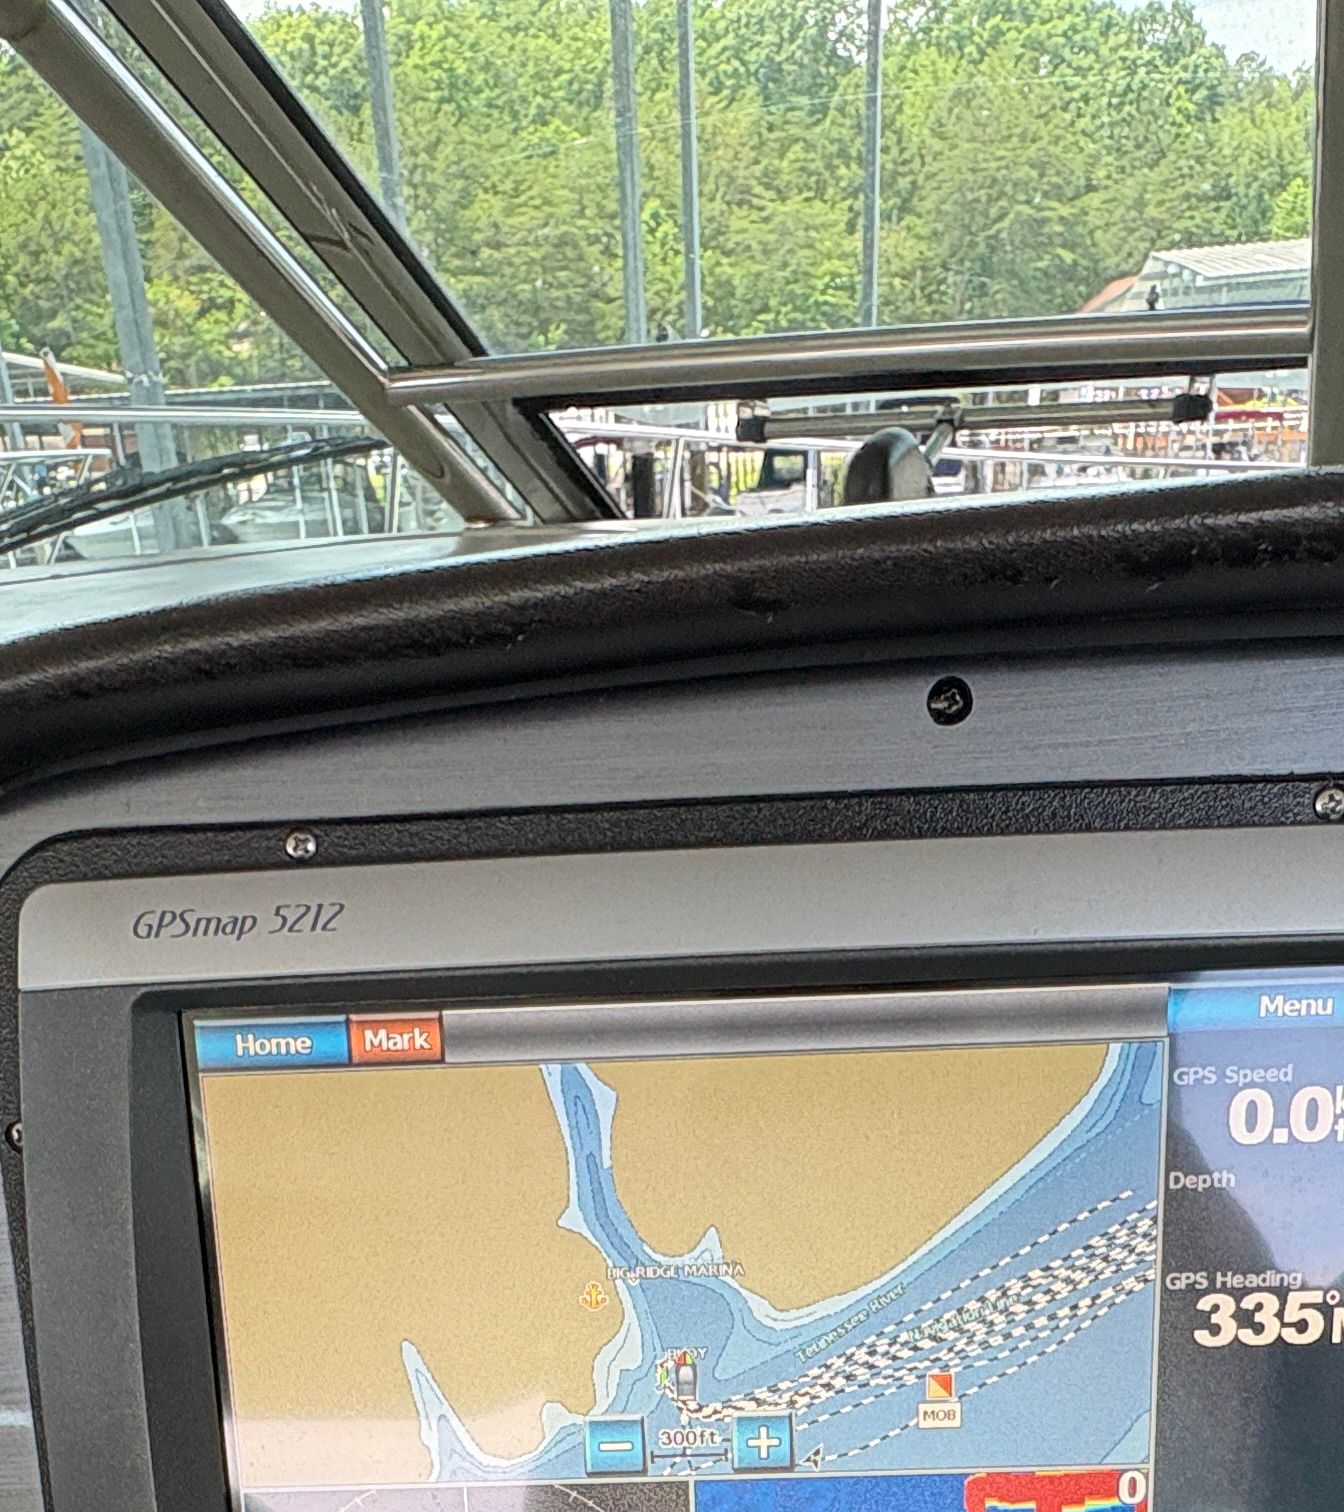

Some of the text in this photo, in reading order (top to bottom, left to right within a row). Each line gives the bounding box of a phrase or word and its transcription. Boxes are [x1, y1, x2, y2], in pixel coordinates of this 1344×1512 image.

[131, 902, 346, 941] GPSmap 5212
[1259, 993, 1334, 1018] Menu
[234, 1031, 313, 1057] Home
[362, 1028, 432, 1053] Mark
[1172, 1063, 1293, 1087] GPS Speed
[1168, 1169, 1236, 1193] Depth
[683, 1261, 746, 1278] MARINA
[1165, 1268, 1303, 1291] GPS Heading
[922, 1408, 957, 1423] MOB
[660, 1429, 719, 1447] 300ft
[1118, 1470, 1147, 1505] 0
